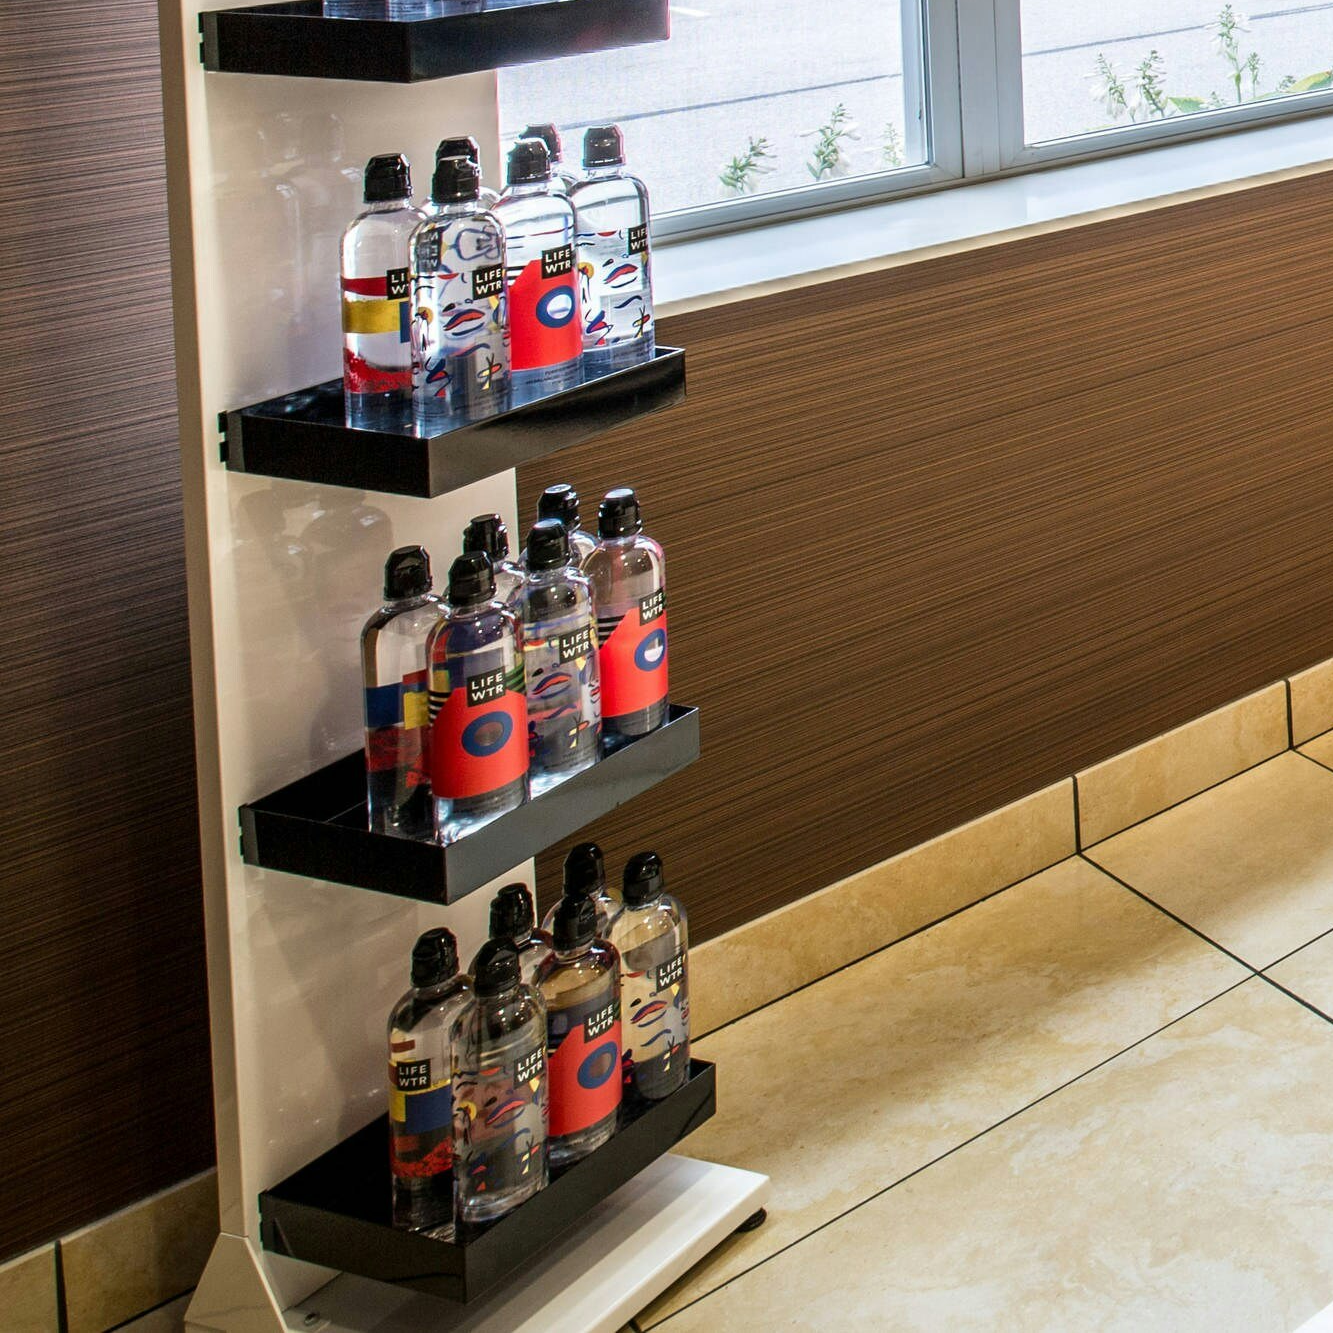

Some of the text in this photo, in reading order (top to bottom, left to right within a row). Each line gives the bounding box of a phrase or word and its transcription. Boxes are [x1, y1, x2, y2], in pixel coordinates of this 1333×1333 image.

[630, 228, 648, 241] LIF
[630, 239, 648, 252] WT
[544, 249, 571, 264] LIFE
[475, 268, 503, 282] LIFE
[544, 260, 571, 275] WTR
[475, 280, 504, 295] WTR
[642, 594, 664, 611] LIFE
[641, 604, 665, 621] WTR
[562, 630, 590, 648] LIFE
[562, 641, 590, 660] WTR
[471, 672, 505, 690] LIFE
[471, 684, 505, 703] WTR
[659, 958, 683, 978] LIFE
[659, 967, 683, 988] WTR
[588, 1006, 614, 1025] LIFE
[588, 1016, 614, 1038] WTR
[517, 1047, 544, 1072] LIFE
[398, 1064, 427, 1077] LIFE
[517, 1059, 544, 1083] WTR
[398, 1075, 427, 1088] WTR
